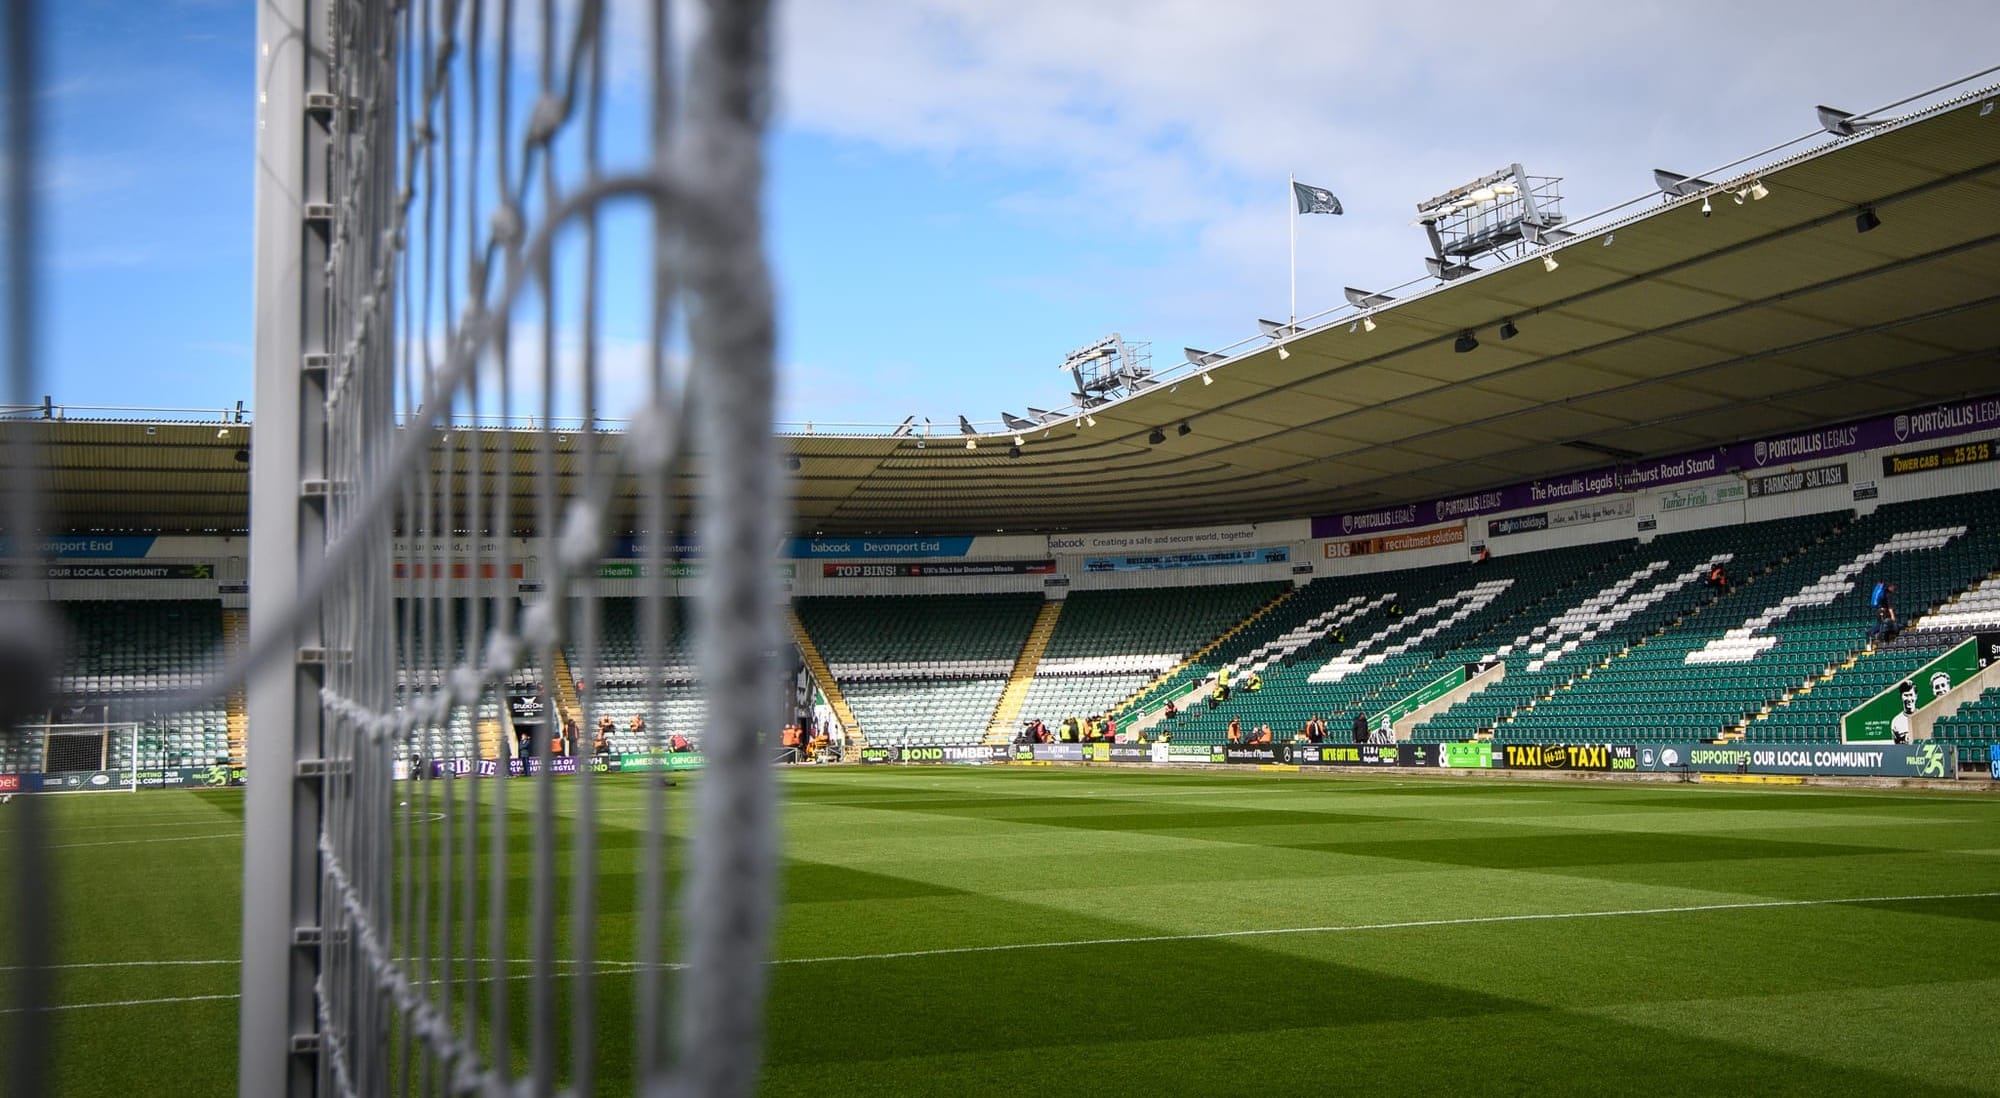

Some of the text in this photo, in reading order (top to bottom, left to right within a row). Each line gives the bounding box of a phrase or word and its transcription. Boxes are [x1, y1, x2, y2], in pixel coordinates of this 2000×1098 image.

[1911, 405, 1973, 434] PORTCULLIS
[1769, 427, 1857, 459] PORTCULLIS LEGALS
[1892, 457, 1919, 473] TOWER
[1919, 453, 1939, 468] CABS
[1954, 447, 1965, 464] 25
[1966, 445, 1977, 462] 25
[1977, 443, 1989, 460] 25
[1531, 487, 1546, 501] The
[1547, 479, 1584, 498] Portcullis
[1586, 474, 1613, 494] Legals
[1660, 459, 1684, 479] Road
[1687, 454, 1715, 474] Stand
[1763, 473, 1804, 494] FARMSHOP
[1806, 467, 1841, 488] SALTASH
[1354, 511, 1391, 529] PORTCULLIS
[89, 541, 113, 551] End
[811, 541, 940, 554] babcock Devonport End
[1093, 537, 1127, 548] Creating
[1135, 536, 1152, 546] safe
[1154, 535, 1169, 544] and
[1169, 535, 1193, 543] secure
[1221, 531, 1254, 542] together
[1385, 534, 1431, 550] recruitment
[1431, 529, 1463, 544] solutions
[48, 568, 71, 577] OUR
[73, 568, 107, 577] LOCAL
[107, 568, 169, 577] COMMUNITY
[836, 565, 896, 577] TOP BINS!
[901, 748, 943, 760] BOND
[943, 746, 994, 760] TIMBER
[1506, 746, 1542, 767] TAXI
[1567, 746, 1607, 769] TAXI
[1615, 747, 1632, 758] WH
[1690, 749, 1884, 770] SUPPORTING OUR LOCAL COMMUNITY
[1612, 758, 1636, 770] BOND
[1905, 756, 1926, 767] PROJECT
